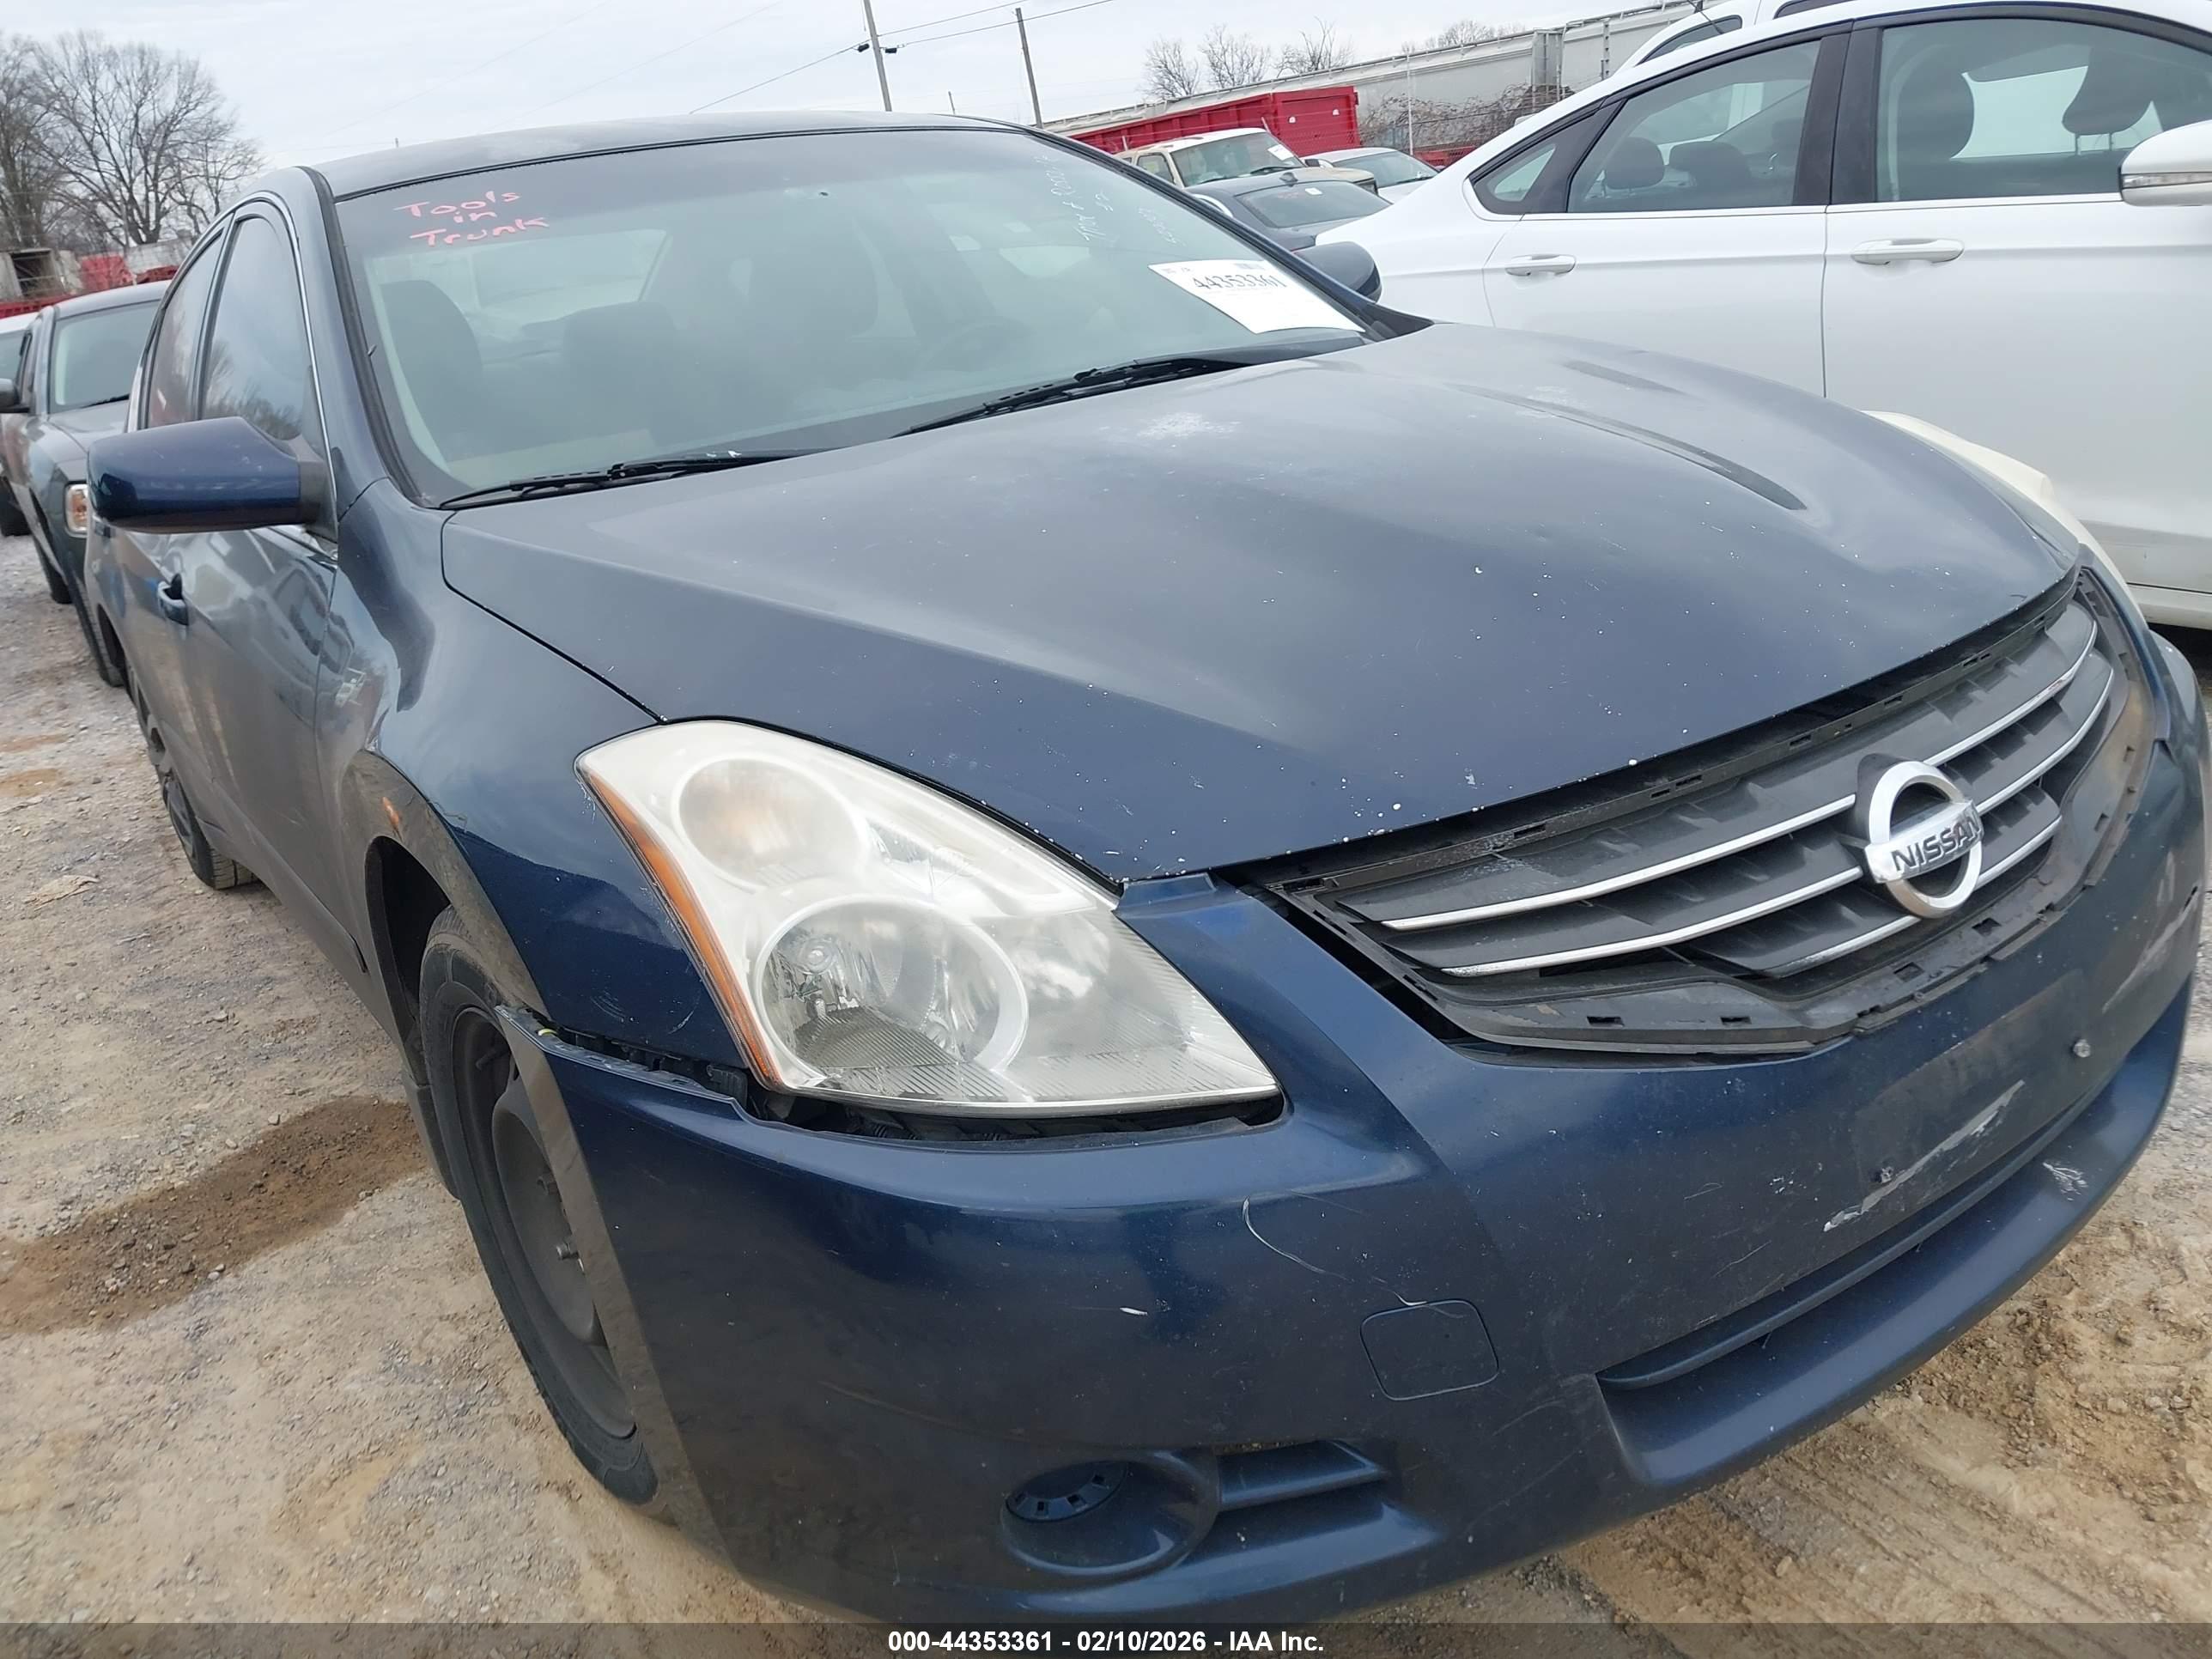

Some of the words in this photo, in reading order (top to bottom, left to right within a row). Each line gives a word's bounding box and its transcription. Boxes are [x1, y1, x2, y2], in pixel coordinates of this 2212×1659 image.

[452, 210, 498, 223] in
[1193, 274, 1288, 289] 44353361
[1891, 812, 1982, 873] NISSAN
